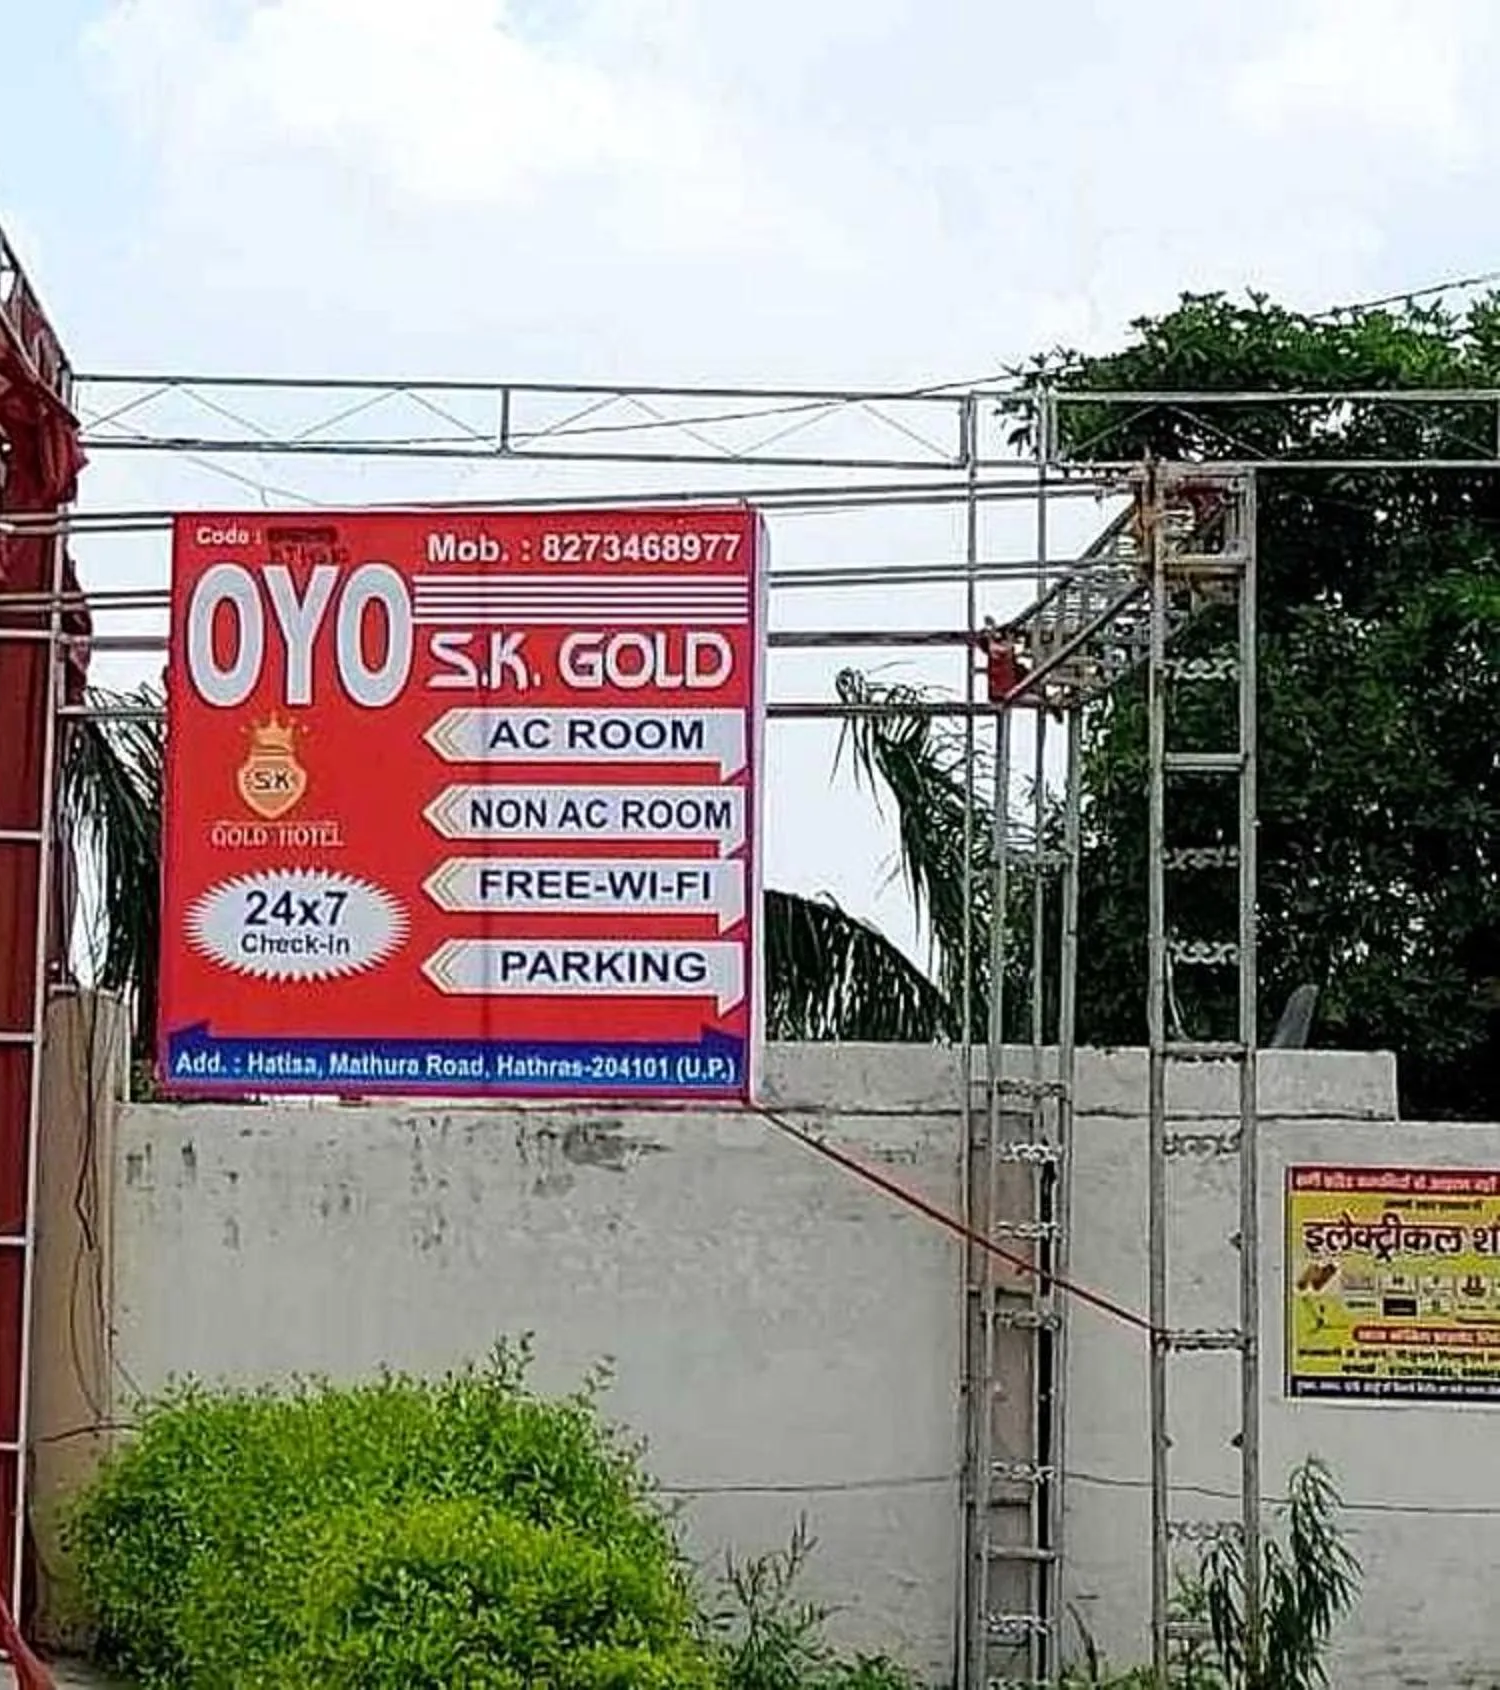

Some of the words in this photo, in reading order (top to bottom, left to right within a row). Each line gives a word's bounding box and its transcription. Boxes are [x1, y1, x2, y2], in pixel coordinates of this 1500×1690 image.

[428, 533, 508, 562] Mob.
[543, 533, 741, 562] 8273468977
[188, 562, 414, 707] OYO
[427, 632, 541, 688] S.K.
[560, 632, 734, 688] GOLD
[489, 719, 552, 750] AC
[568, 719, 705, 750] ROOM
[470, 799, 555, 829] NON
[562, 799, 610, 829] AC
[622, 799, 733, 829] ROOM
[479, 869, 711, 900] FREE-WI-FI
[245, 890, 349, 926] 24x7
[500, 950, 708, 984] PARKING
[176, 1051, 227, 1074] Add.
[329, 1053, 420, 1076] Mathura
[426, 1054, 491, 1079] Road,
[498, 1056, 669, 1078] Hathras-204101
